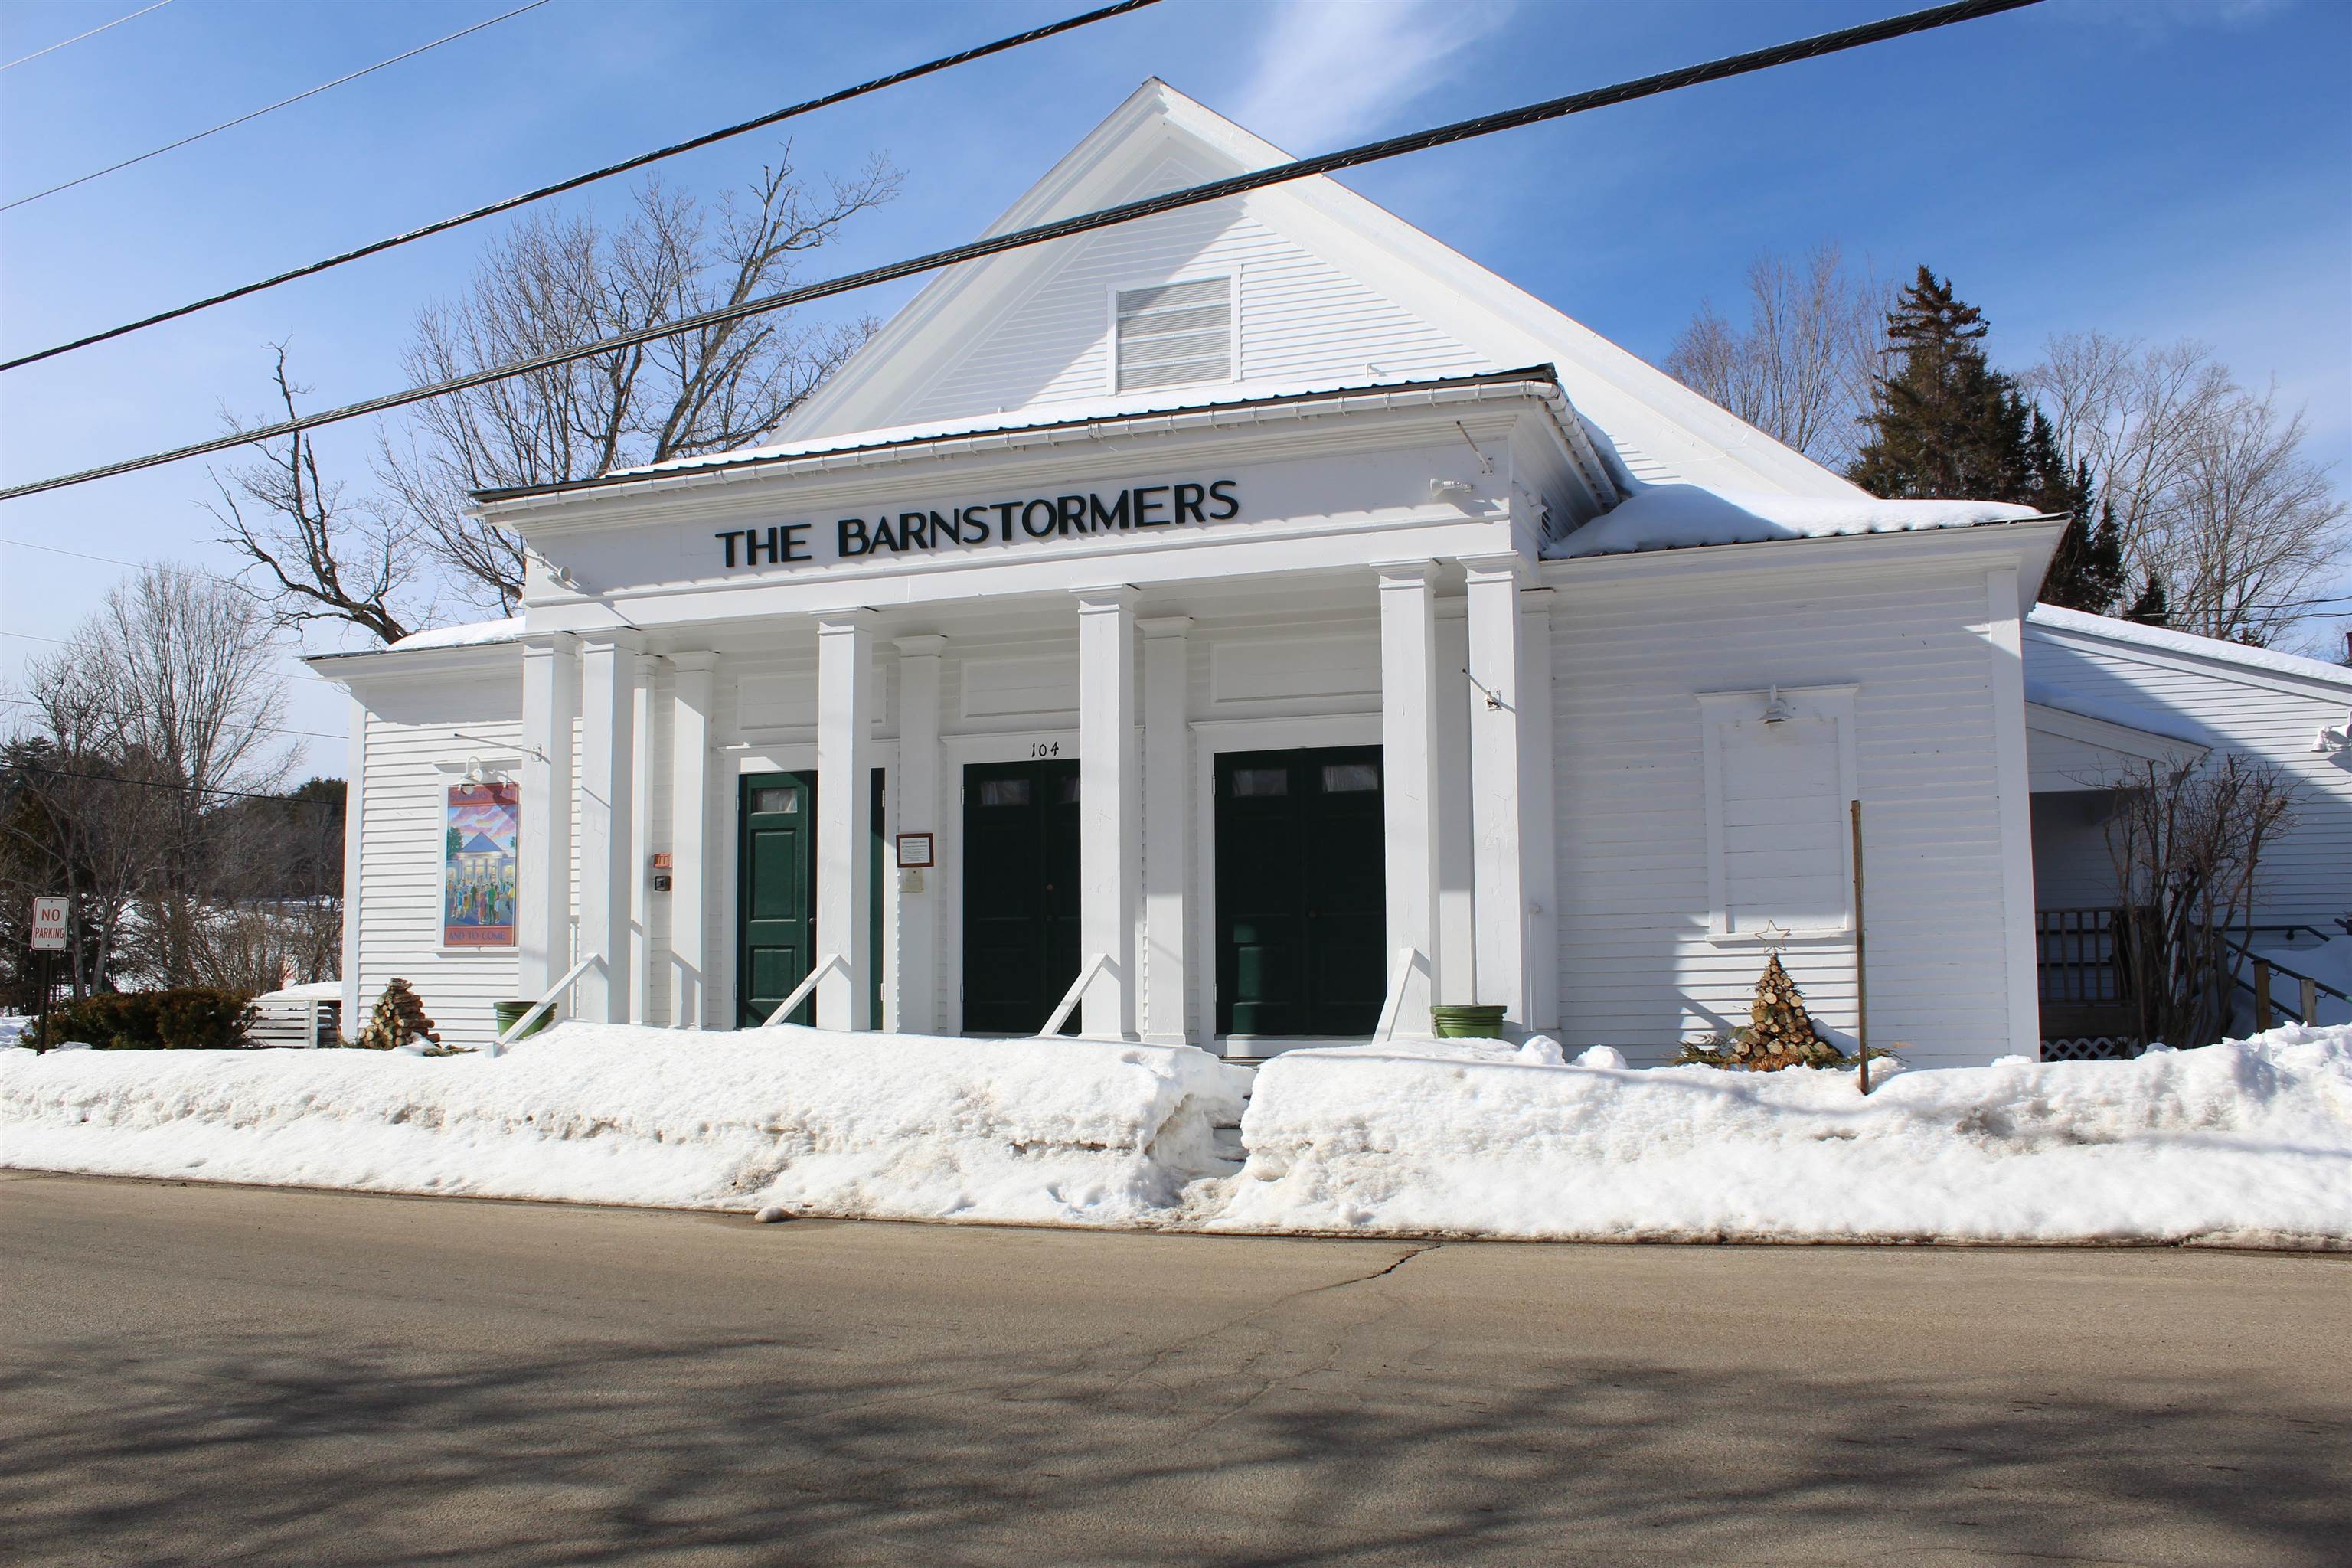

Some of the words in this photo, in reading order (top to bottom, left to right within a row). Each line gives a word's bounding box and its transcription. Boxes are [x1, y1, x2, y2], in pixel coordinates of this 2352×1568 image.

[714, 522, 813, 568] THE
[838, 479, 1240, 558] BARNSTORMERS
[1031, 741, 1060, 758] 104
[41, 908, 60, 922] NO
[34, 926, 64, 939] PARKING
[449, 931, 465, 940] AND
[469, 930, 479, 939] TO
[482, 930, 506, 940] COME
